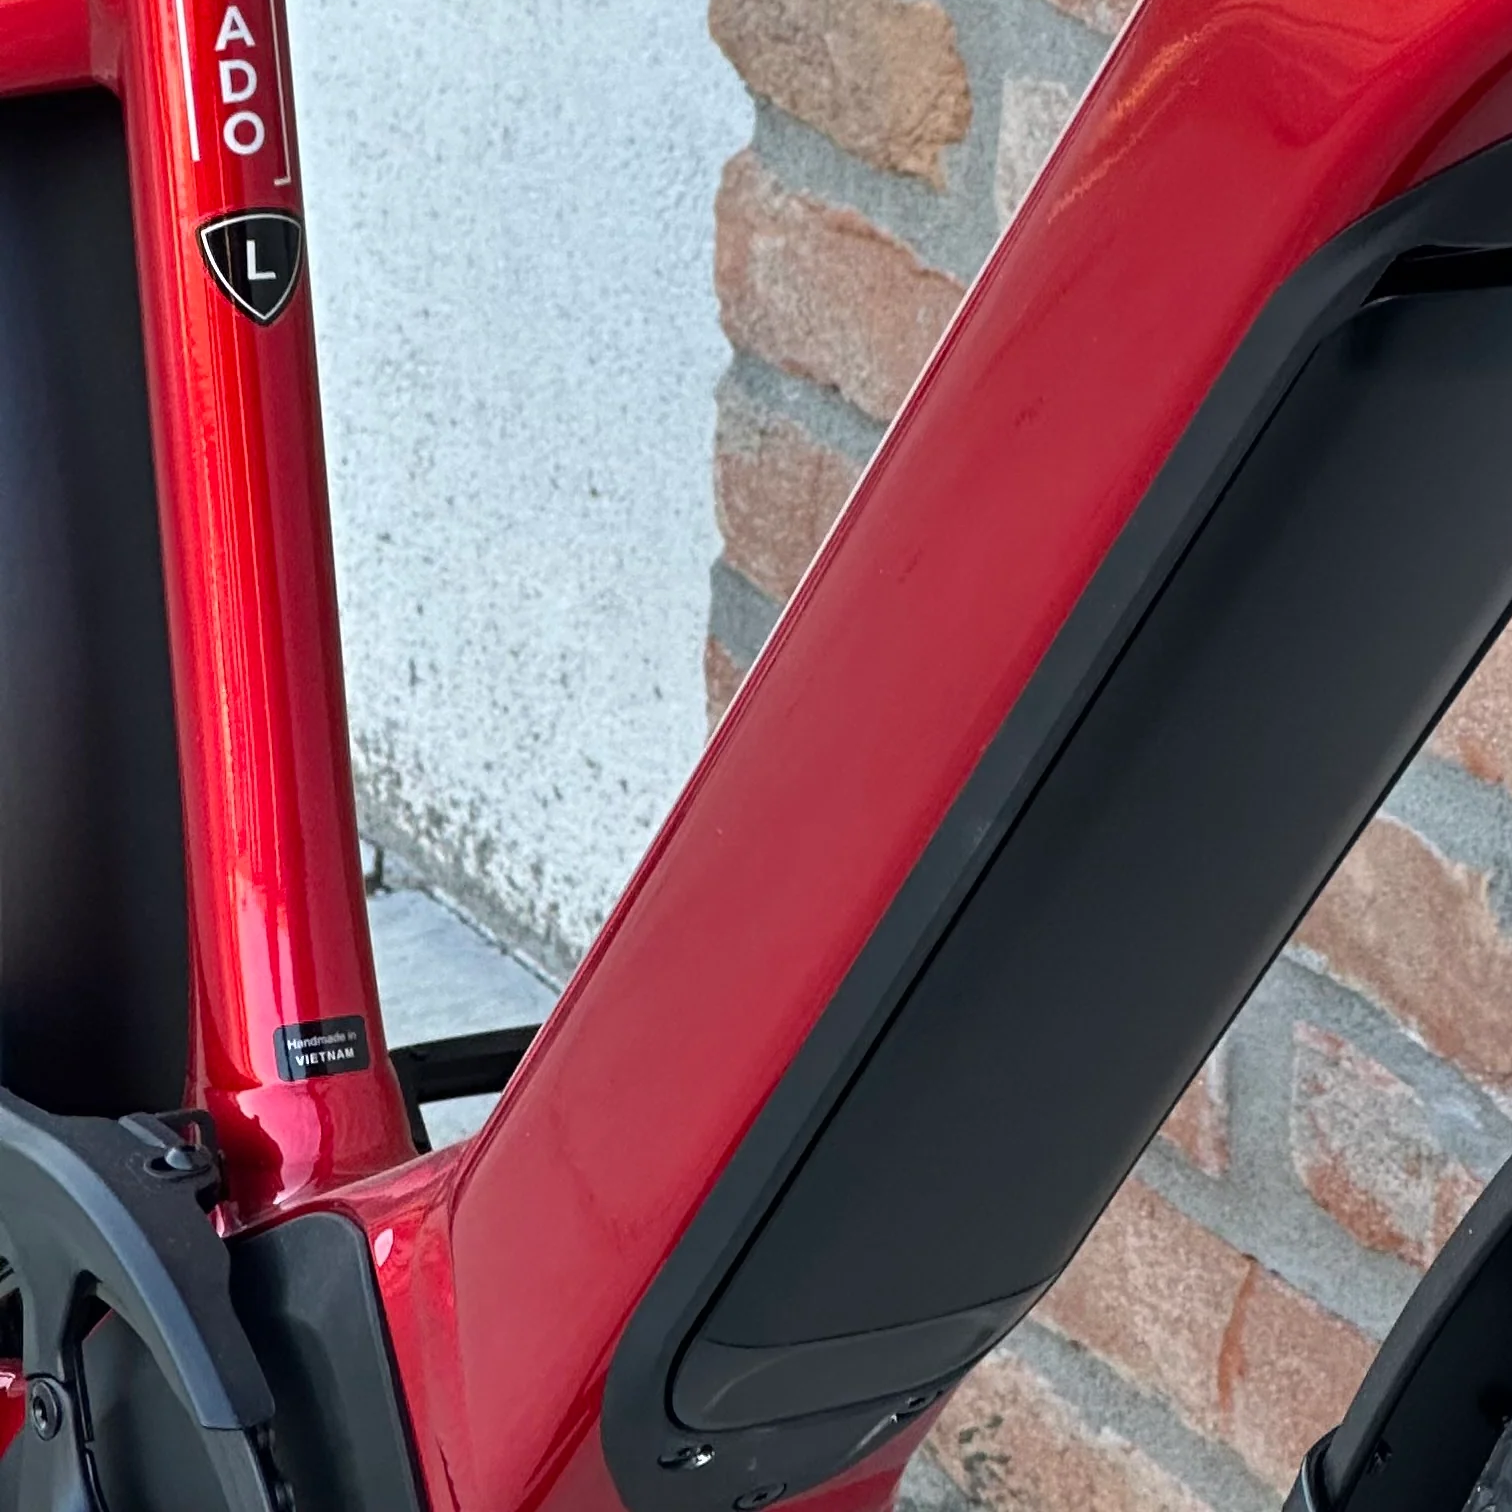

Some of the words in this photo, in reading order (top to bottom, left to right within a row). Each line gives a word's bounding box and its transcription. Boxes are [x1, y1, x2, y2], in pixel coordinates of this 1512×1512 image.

[245, 239, 278, 281] L
[286, 1032, 346, 1051] Handmade
[295, 1047, 355, 1066] VIETNAM
